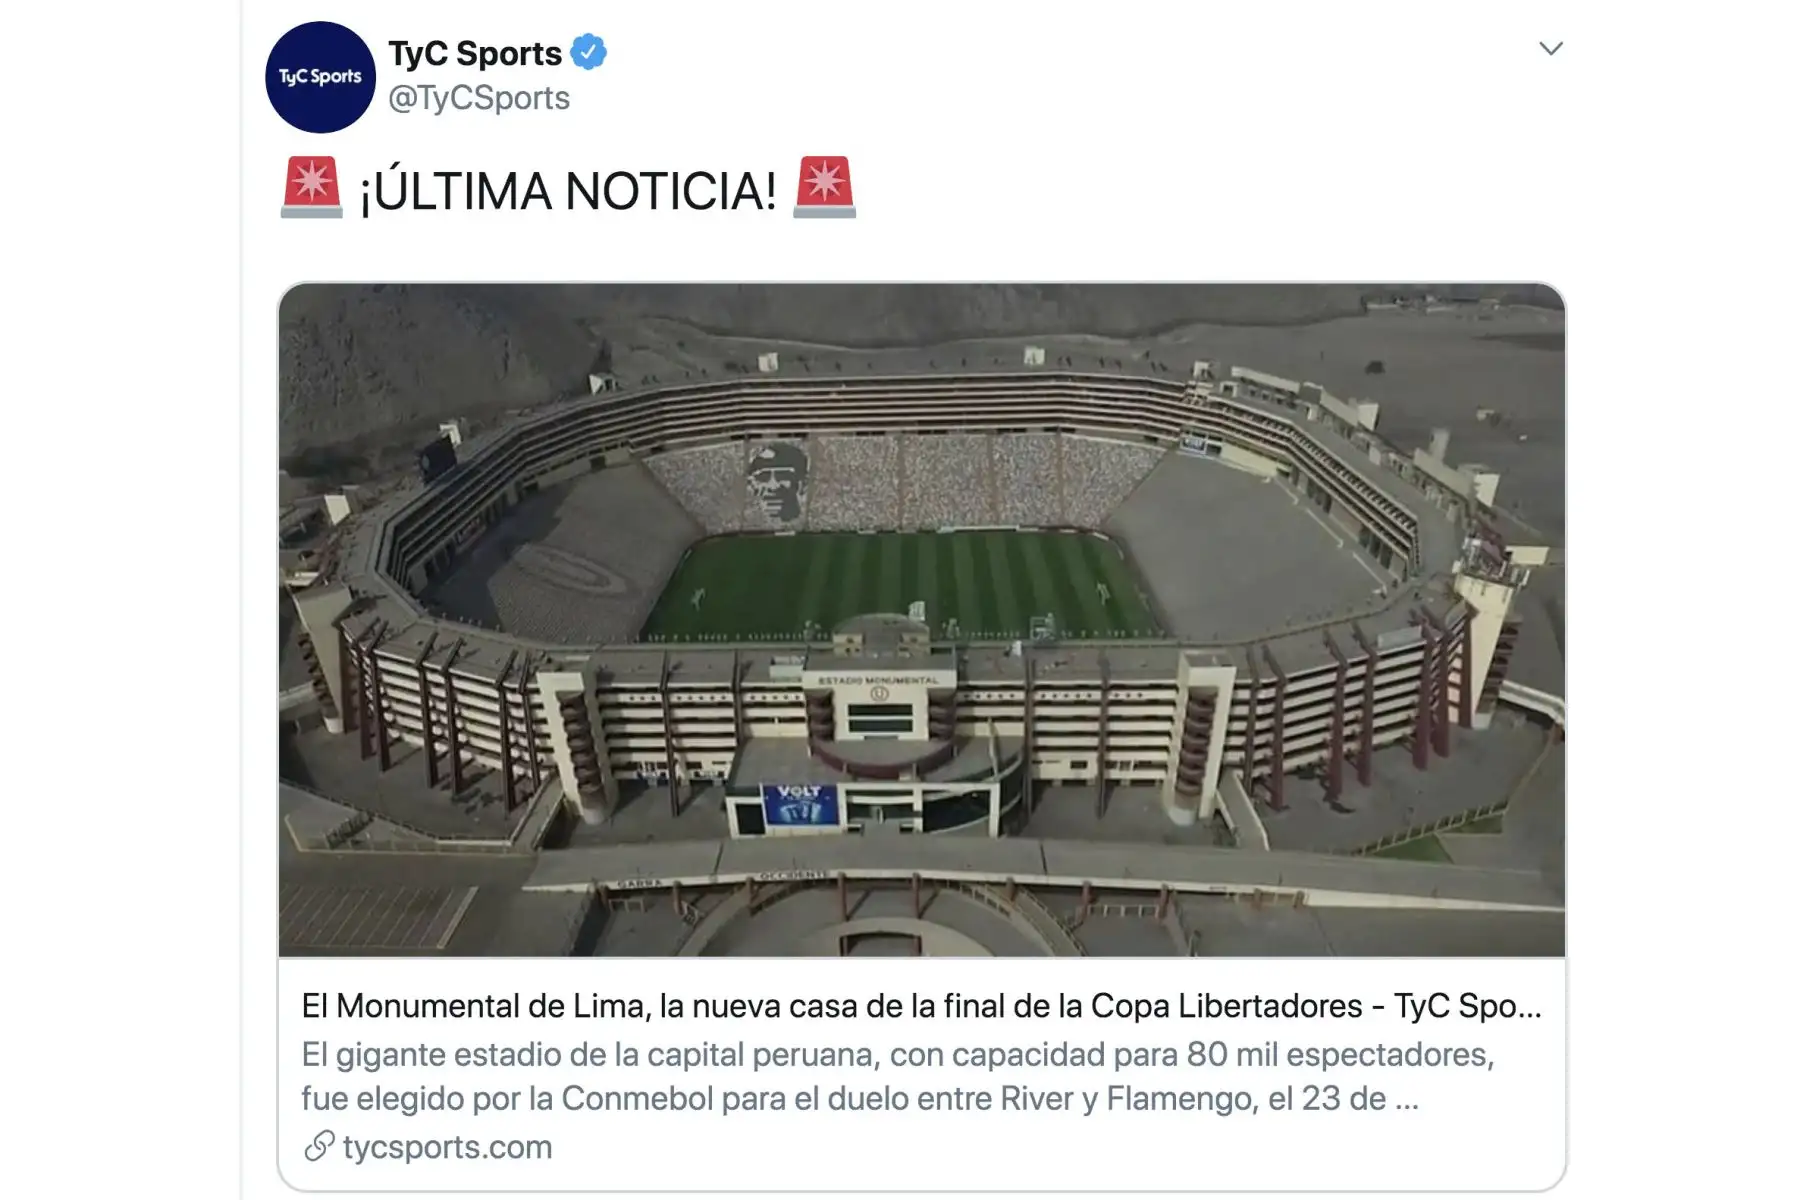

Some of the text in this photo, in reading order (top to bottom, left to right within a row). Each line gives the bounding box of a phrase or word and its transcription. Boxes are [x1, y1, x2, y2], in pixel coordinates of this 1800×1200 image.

[388, 40, 562, 72] TyC Sports
[278, 68, 362, 88] TyC Sports
[388, 84, 570, 116] @TyCSports
[361, 161, 776, 218] ¡ÚLTIMA NOTICIA!
[818, 676, 939, 685] ESTADIO MONUMENTAL
[777, 785, 822, 797] VOLT
[304, 993, 326, 1018] El
[338, 993, 519, 1018] Monumental
[529, 993, 564, 1018] de
[575, 993, 651, 1022] Lima,
[661, 993, 683, 1018] la
[694, 999, 780, 1018] nueva
[790, 999, 857, 1018] casa
[867, 993, 903, 1018] de
[913, 993, 935, 1018] la
[944, 993, 1004, 1018] final
[1014, 993, 1050, 1018] de
[1060, 993, 1082, 1018] la
[1092, 992, 1169, 1023] Copa
[1180, 993, 1362, 1018] Libertadores
[1394, 992, 1450, 1024] TyC
[1459, 992, 1541, 1023] Spo...
[304, 1041, 1493, 1072] El gigante estadio de la capital peruana, con capacidad para 80 mil espectadores,
[302, 1085, 348, 1110] fue
[357, 1085, 464, 1116] elegido
[474, 1092, 521, 1116] por
[531, 1085, 552, 1110] la
[563, 1085, 712, 1110] Conmebol
[723, 1092, 785, 1116] para
[795, 1085, 818, 1110] el
[829, 1085, 909, 1110] duelo
[918, 1088, 992, 1110] entre
[1003, 1085, 1074, 1110] River
[1082, 1092, 1098, 1116] y
[1109, 1085, 1258, 1116] Flamengo,
[1269, 1085, 1292, 1110] el
[1303, 1085, 1340, 1110] 23
[1351, 1085, 1386, 1110] de
[343, 1136, 552, 1165] tycsports.com
